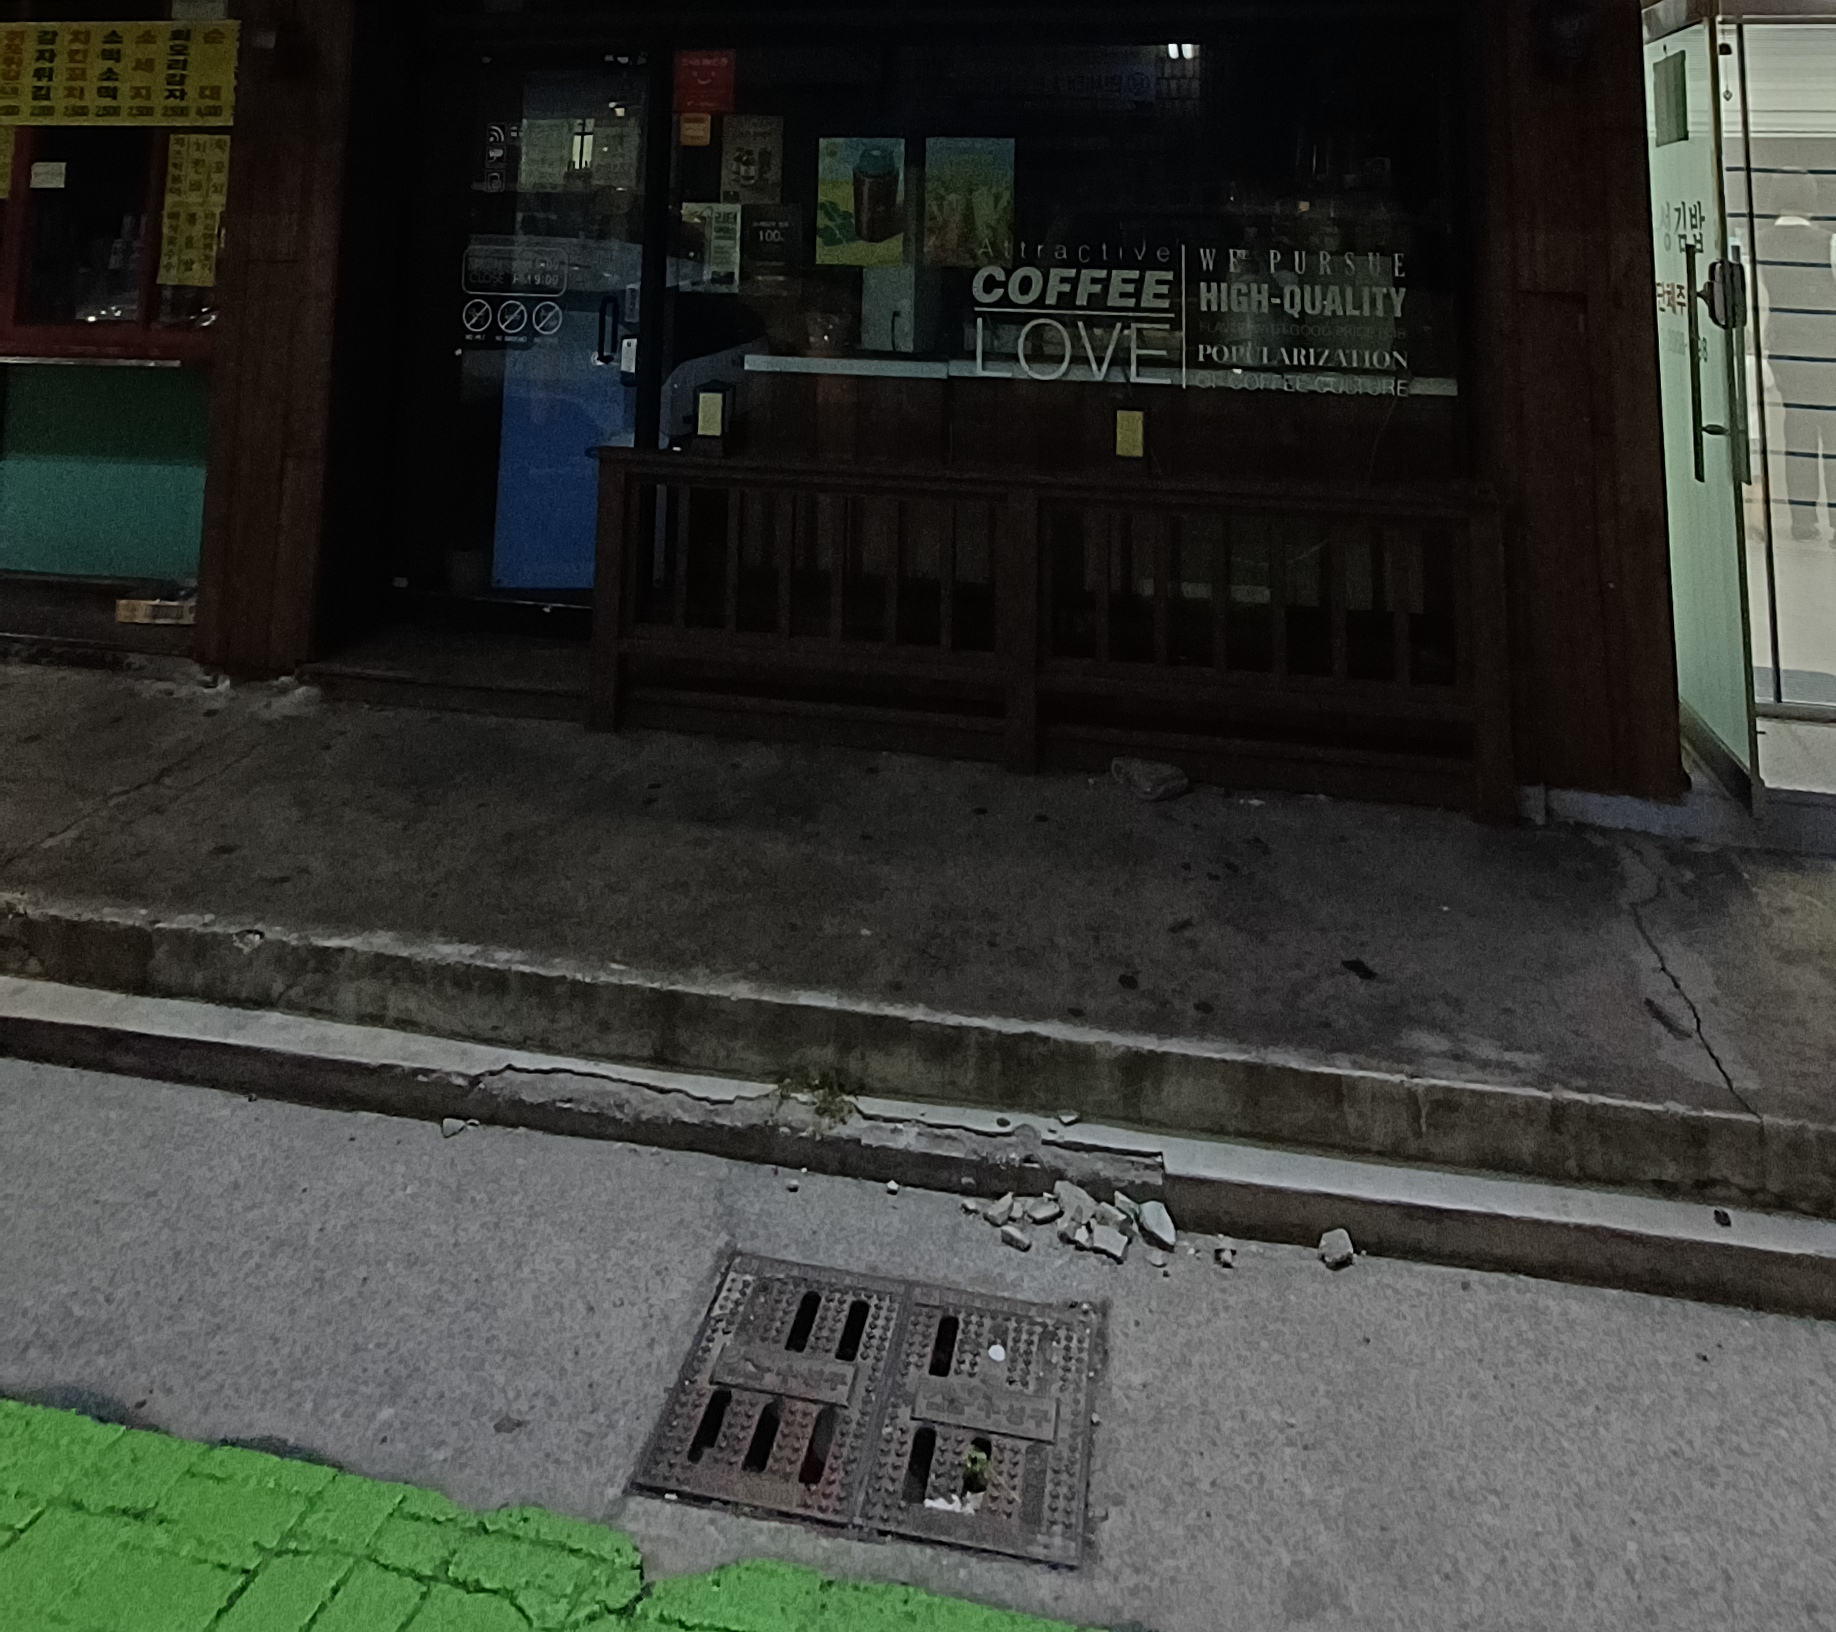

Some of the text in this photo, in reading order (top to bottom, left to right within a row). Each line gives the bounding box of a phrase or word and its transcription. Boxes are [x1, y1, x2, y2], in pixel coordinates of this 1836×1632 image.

[976, 237, 1171, 264] Attractive
[1269, 249, 1406, 278] PURSUE
[971, 265, 1175, 309] COFFEE
[1198, 281, 1408, 319] HIGH-QUALITY
[975, 317, 1172, 384] LOVE
[1197, 342, 1409, 370] POPULARIZATION
